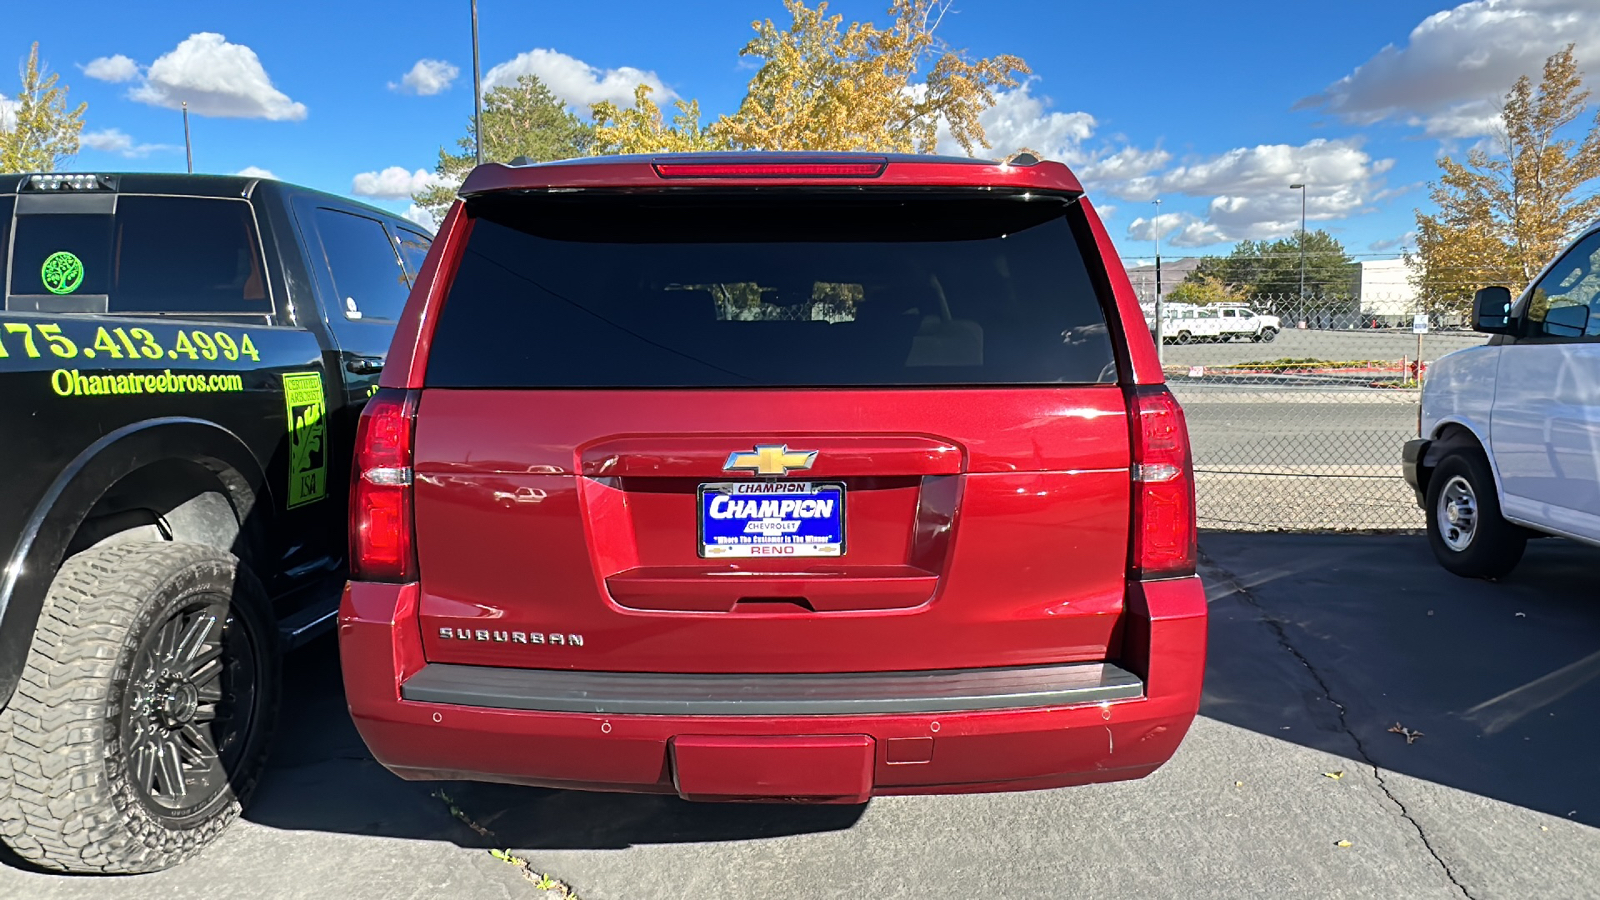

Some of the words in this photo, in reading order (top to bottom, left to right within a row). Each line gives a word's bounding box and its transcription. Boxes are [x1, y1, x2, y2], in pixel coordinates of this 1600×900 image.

[51, 368, 243, 396] Ohanatreebros.com
[287, 378, 319, 391] CERTIFIED
[290, 390, 320, 403] ARBORIST
[300, 472, 316, 498] ISA
[738, 483, 806, 493] CHAMPION
[709, 495, 834, 519] CHAMPION
[747, 521, 796, 530] CHEVROLET
[739, 535, 752, 544] The
[753, 535, 784, 544] Customer
[792, 535, 804, 544] The
[750, 546, 795, 555] RENO
[439, 627, 584, 647] SUBURBAN
